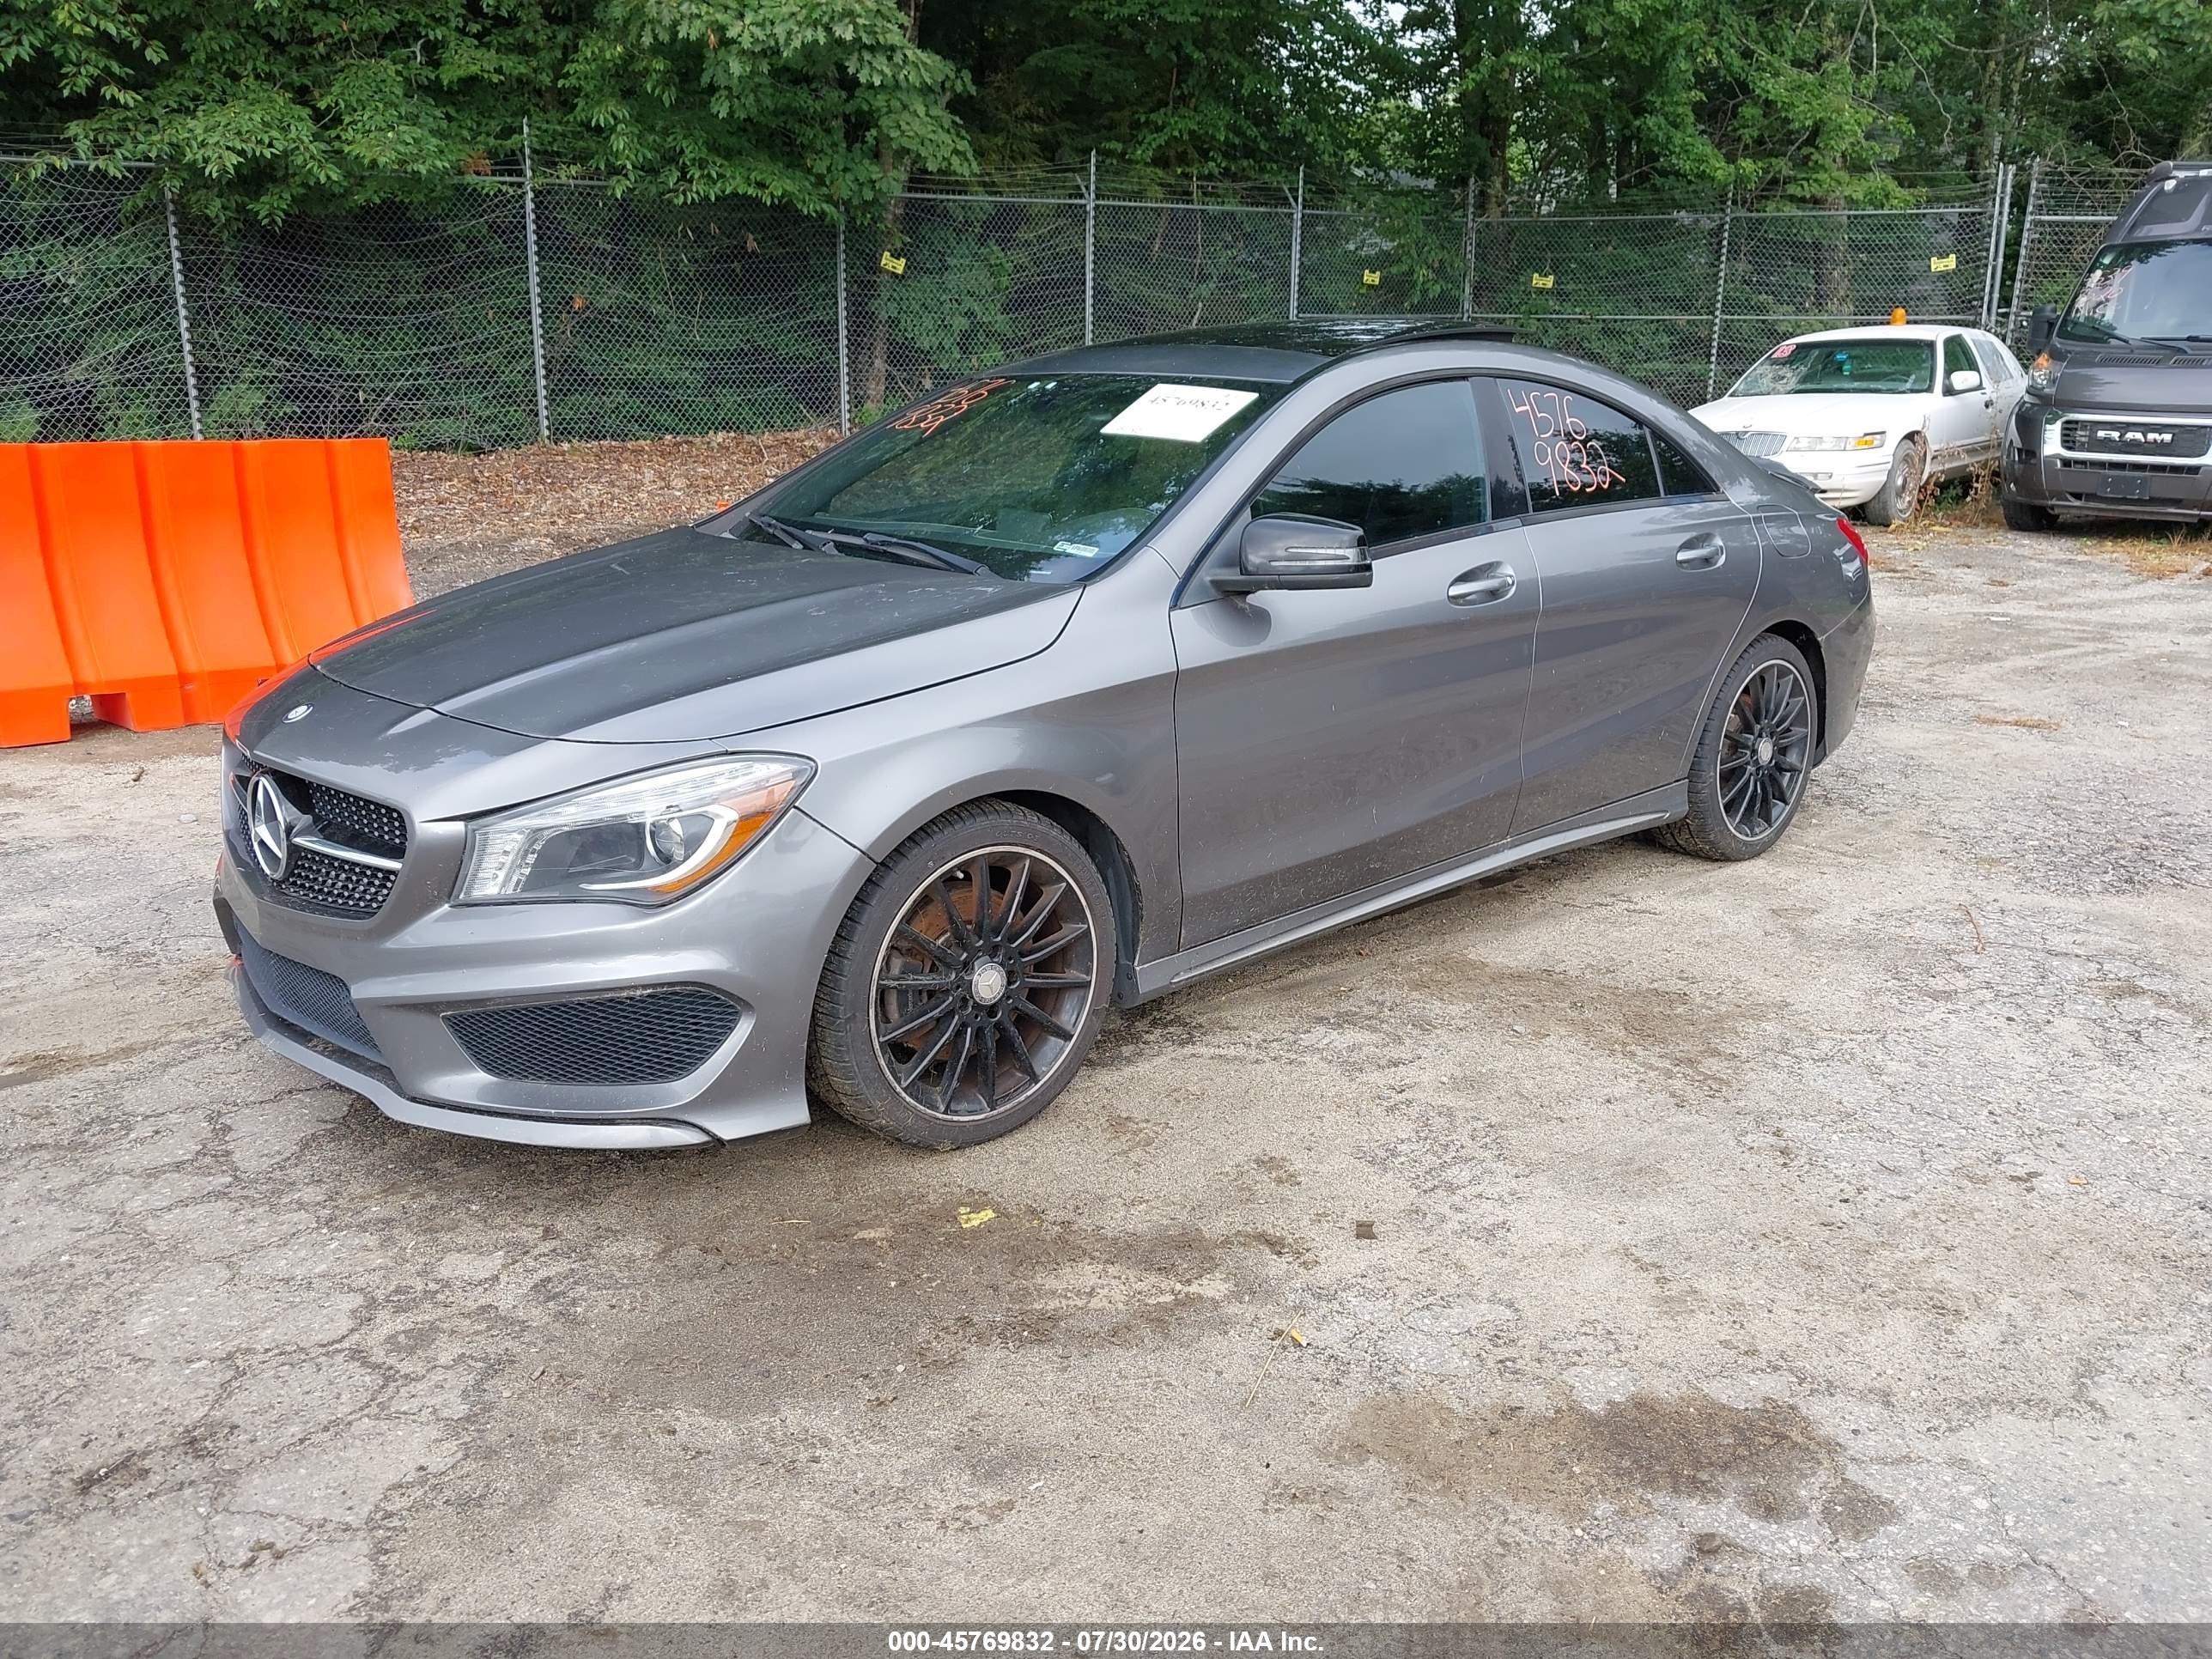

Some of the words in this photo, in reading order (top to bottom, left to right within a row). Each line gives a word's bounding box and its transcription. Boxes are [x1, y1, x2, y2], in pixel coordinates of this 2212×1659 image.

[1507, 389, 1587, 441] 4576
[2096, 429, 2173, 444] RAM
[1534, 441, 1626, 496] 9832
